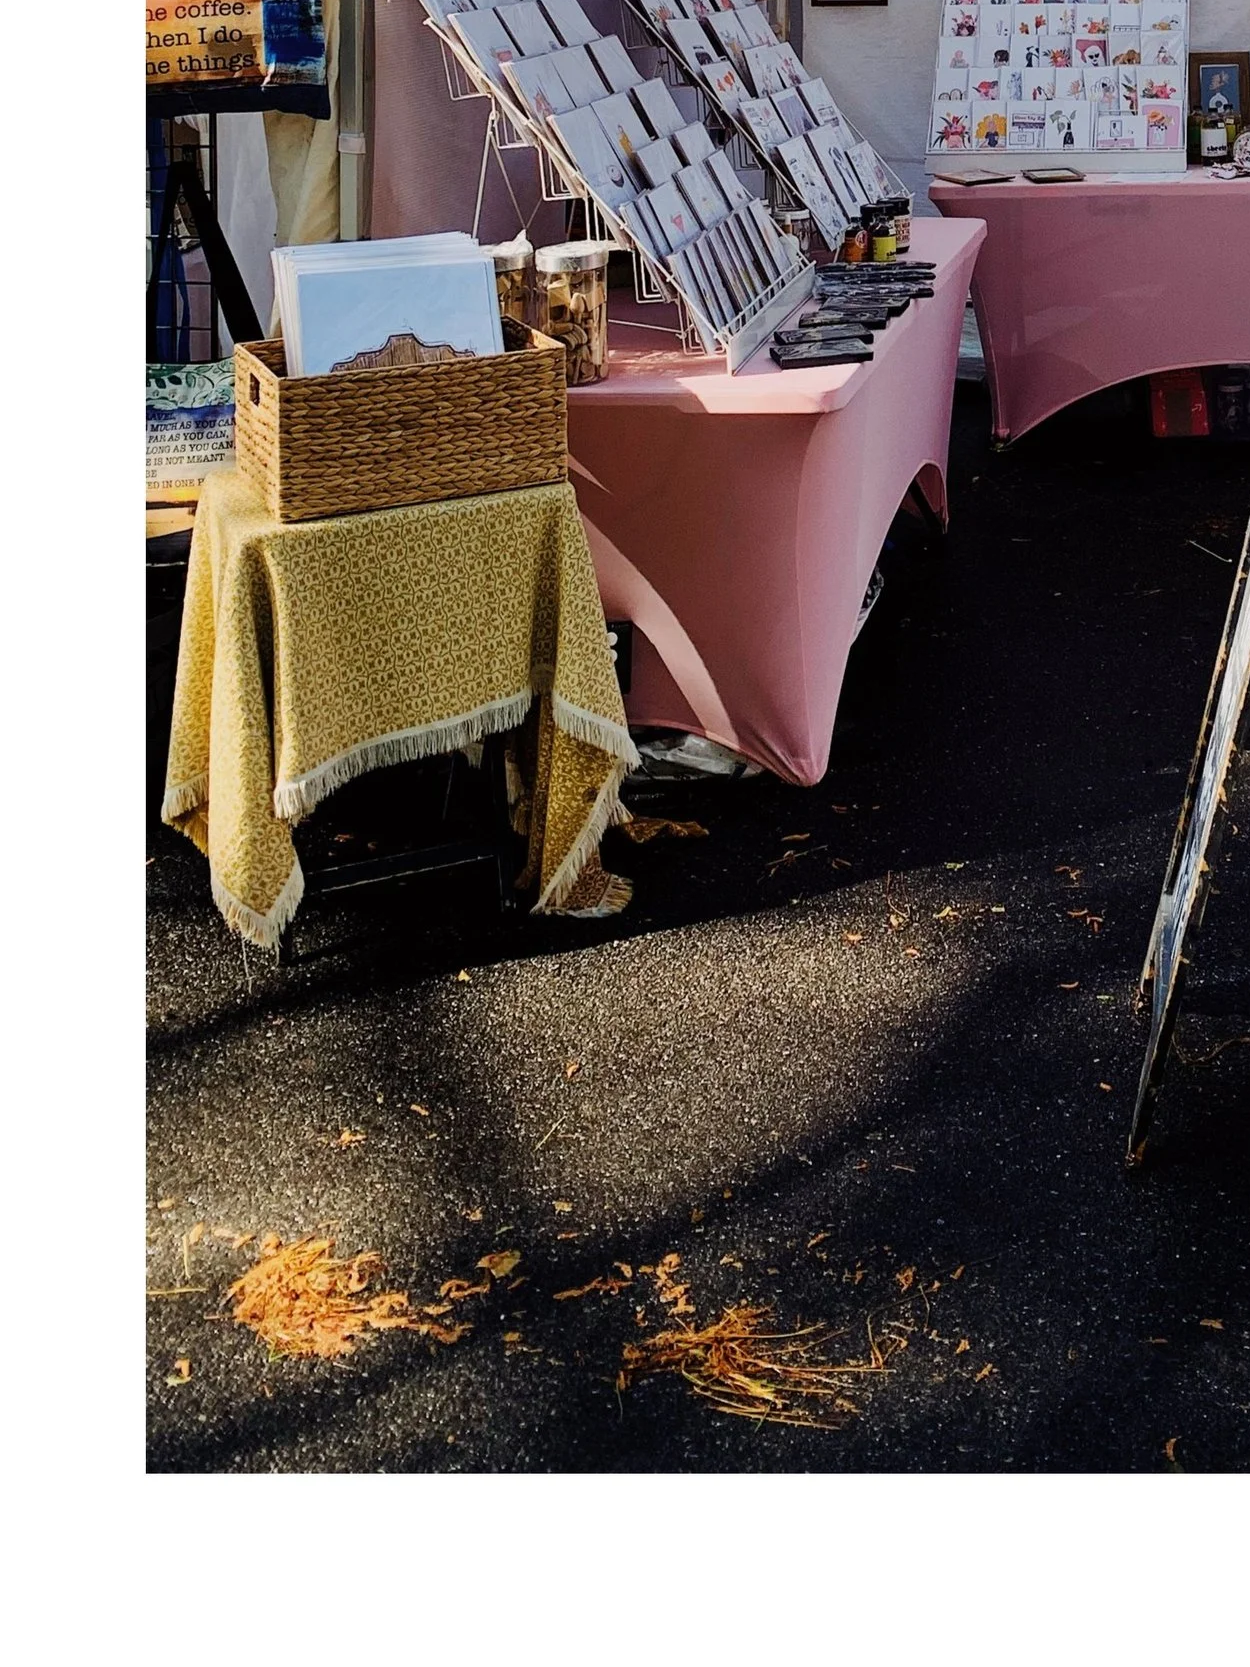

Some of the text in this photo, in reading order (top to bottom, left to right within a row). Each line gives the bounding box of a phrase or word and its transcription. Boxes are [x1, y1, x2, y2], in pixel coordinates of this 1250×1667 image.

[174, 0, 251, 19] coffee.
[197, 27, 208, 44] I
[214, 26, 242, 43] do
[177, 53, 260, 72] things.
[150, 423, 178, 432] MUCH
[179, 421, 192, 430] AS
[195, 420, 217, 429] YOU
[167, 433, 181, 442] AS
[182, 431, 204, 441] YOU
[146, 445, 171, 455] LONG
[173, 444, 186, 453] AS
[189, 443, 210, 452] YOU
[153, 458, 163, 466] IS
[165, 456, 185, 465] NOT
[186, 453, 225, 464] MEANT
[161, 480, 173, 489] IN
[174, 478, 195, 488] ONE
